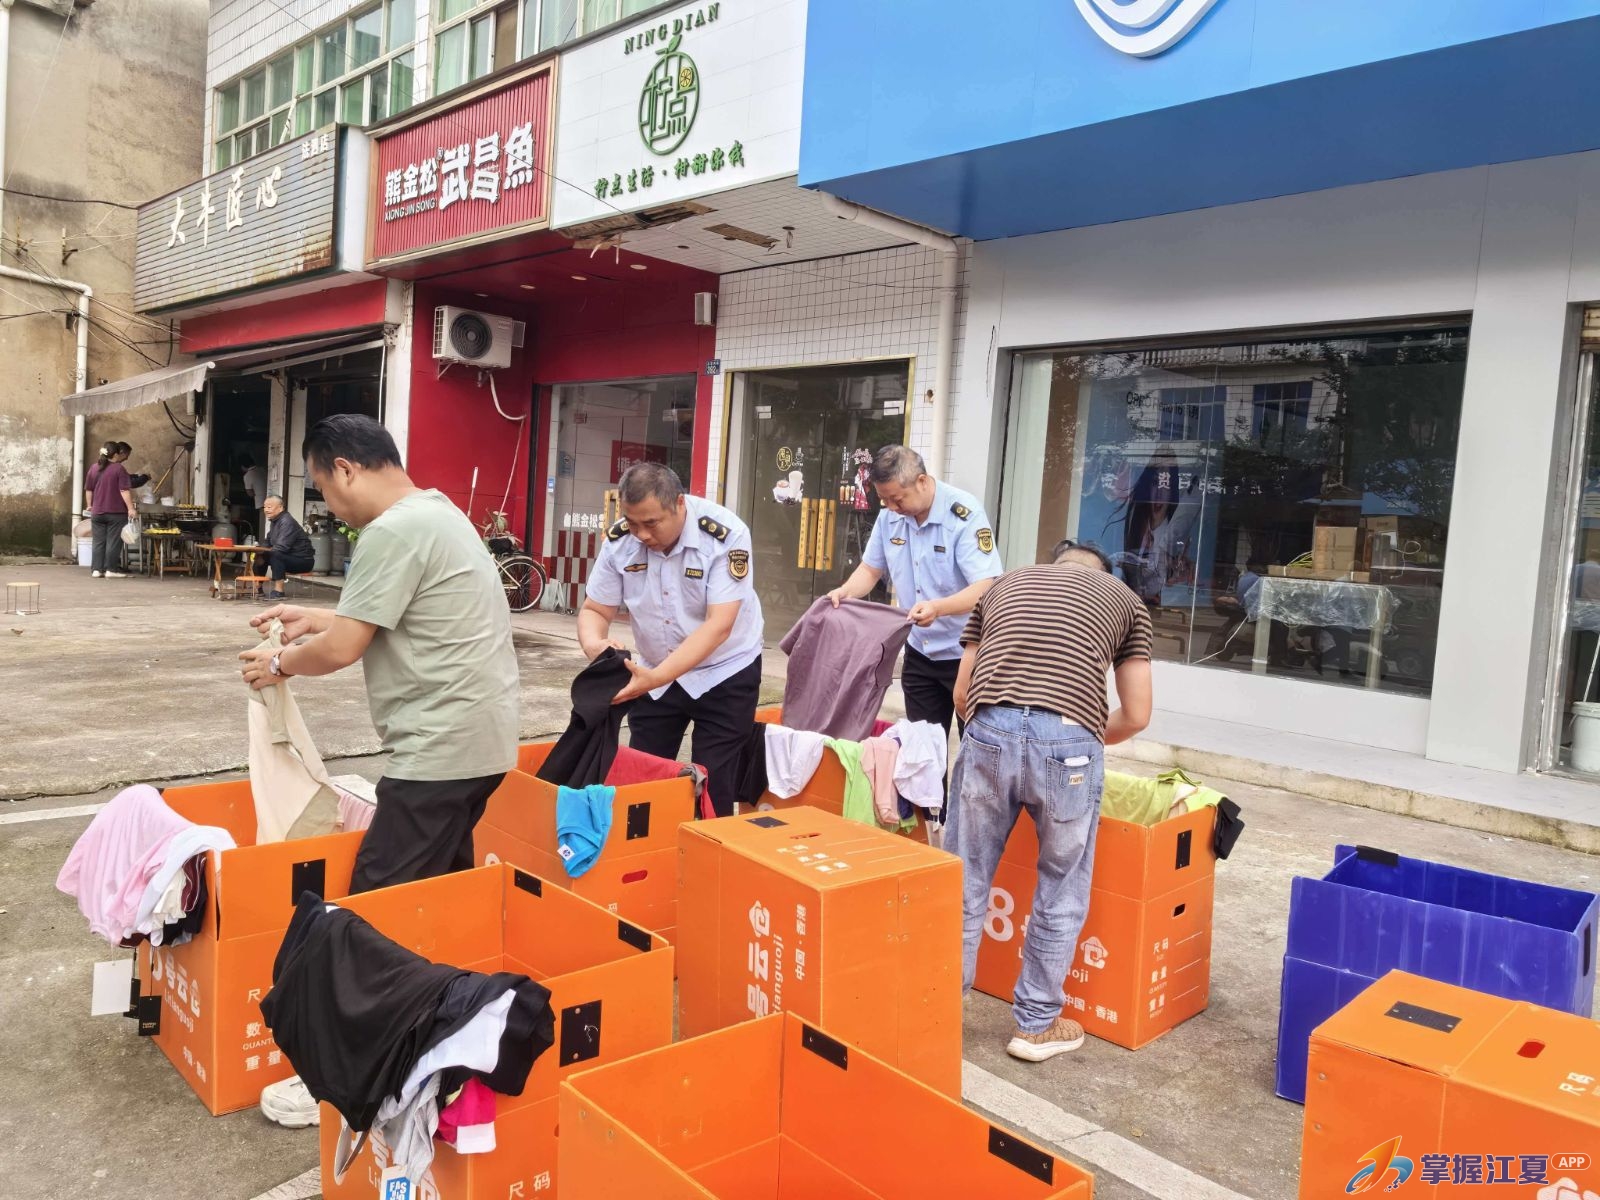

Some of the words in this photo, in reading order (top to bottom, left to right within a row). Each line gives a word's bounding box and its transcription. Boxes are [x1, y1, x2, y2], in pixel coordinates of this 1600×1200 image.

[624, 23, 668, 54] NING
[672, 2, 720, 35] DIAN
[385, 157, 437, 207] 熊金松
[167, 166, 282, 249] 大牛匠心
[385, 207, 405, 221] XIONG
[416, 197, 436, 213] SONG
[509, 1171, 551, 1199] 尺码
